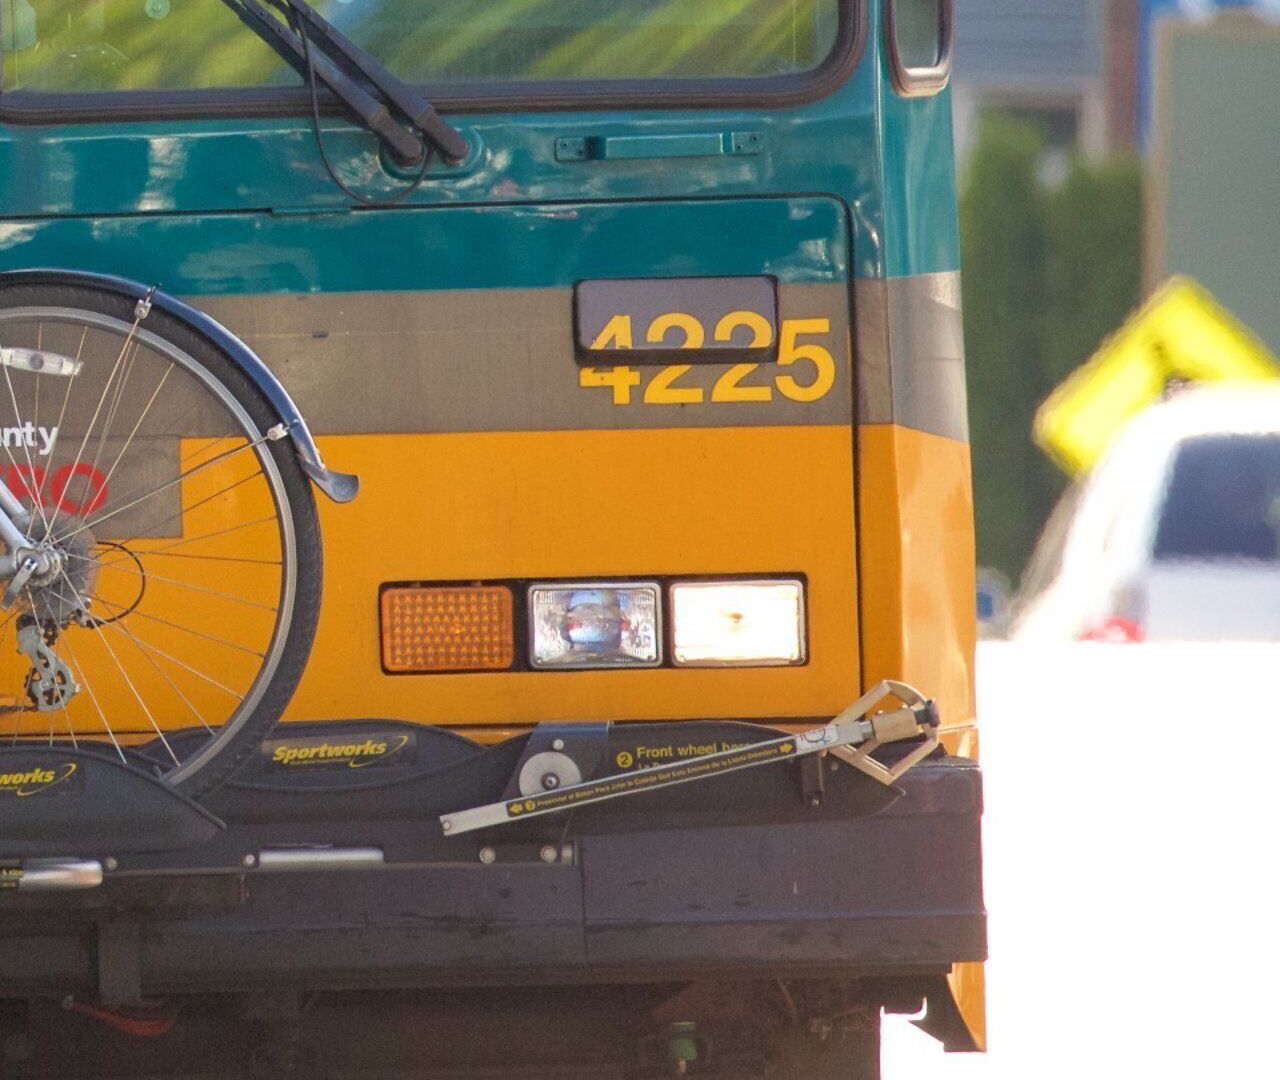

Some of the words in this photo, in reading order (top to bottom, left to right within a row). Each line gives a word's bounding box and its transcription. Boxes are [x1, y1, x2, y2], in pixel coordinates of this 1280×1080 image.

[579, 310, 836, 406] 4225
[272, 740, 387, 764] Sportworks
[636, 745, 672, 759] Front
[677, 741, 718, 755] wheel
